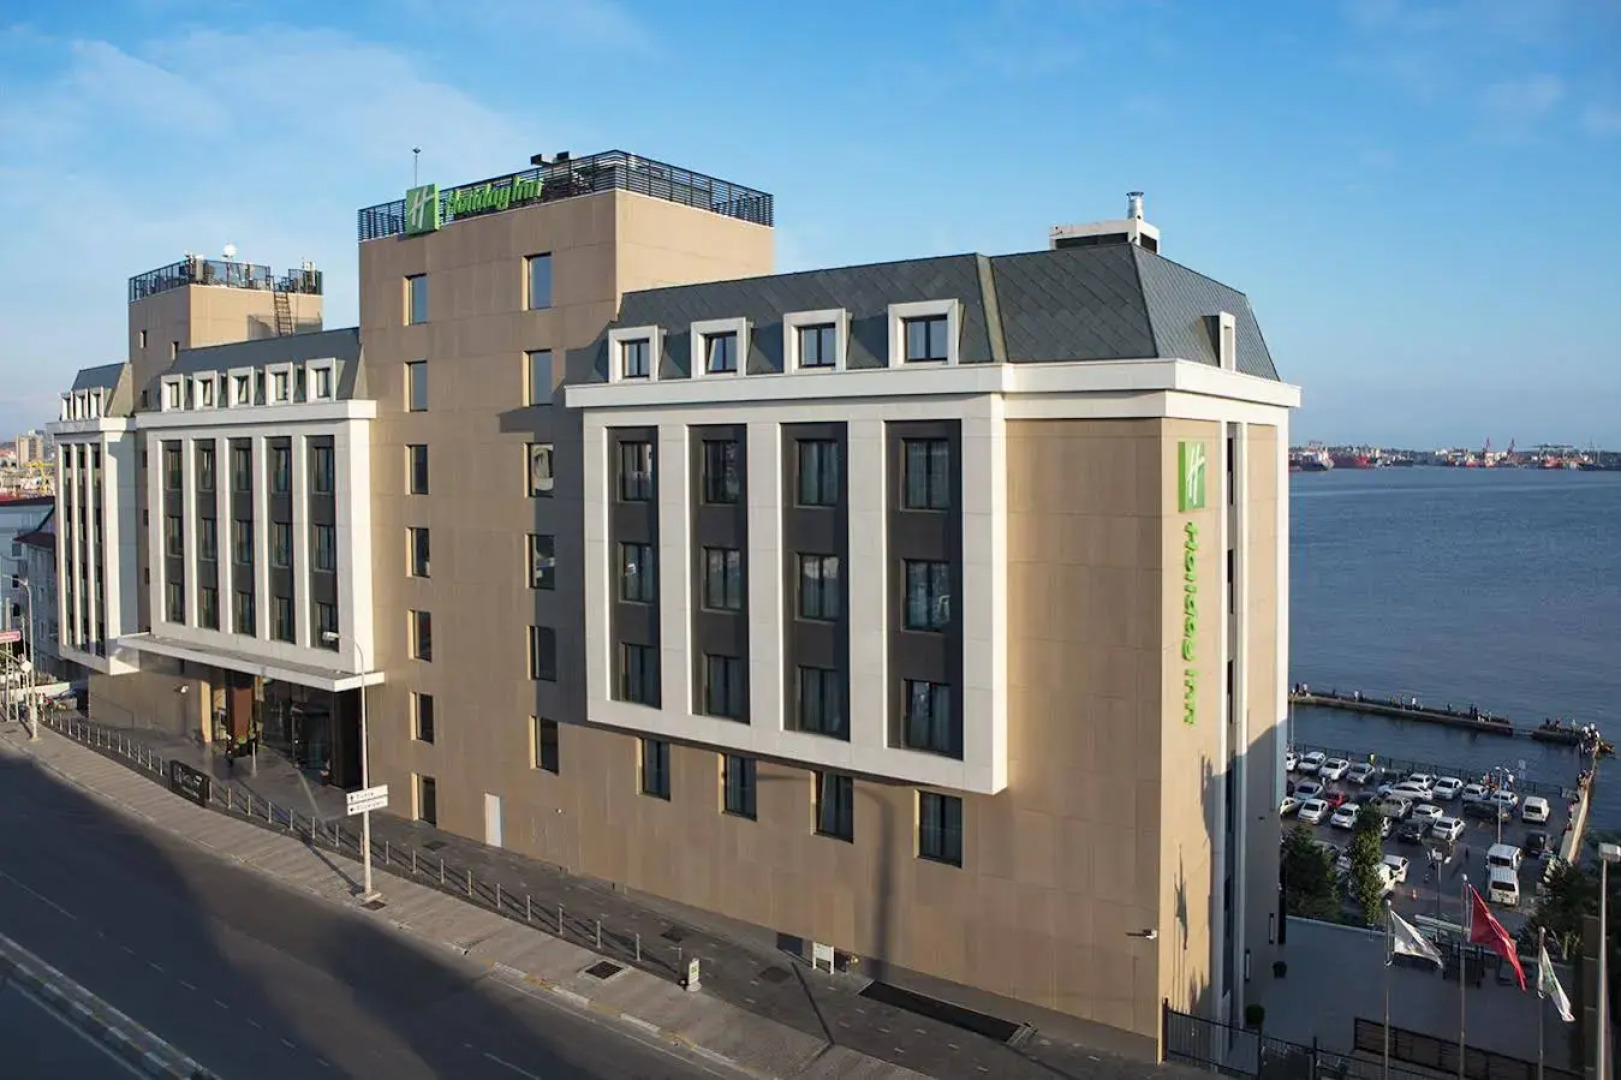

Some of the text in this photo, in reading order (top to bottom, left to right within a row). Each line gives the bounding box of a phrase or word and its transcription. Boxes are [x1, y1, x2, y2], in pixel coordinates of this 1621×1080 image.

[446, 175, 545, 215] Holiday Inn
[1182, 522, 1198, 725] Holiday Inn
